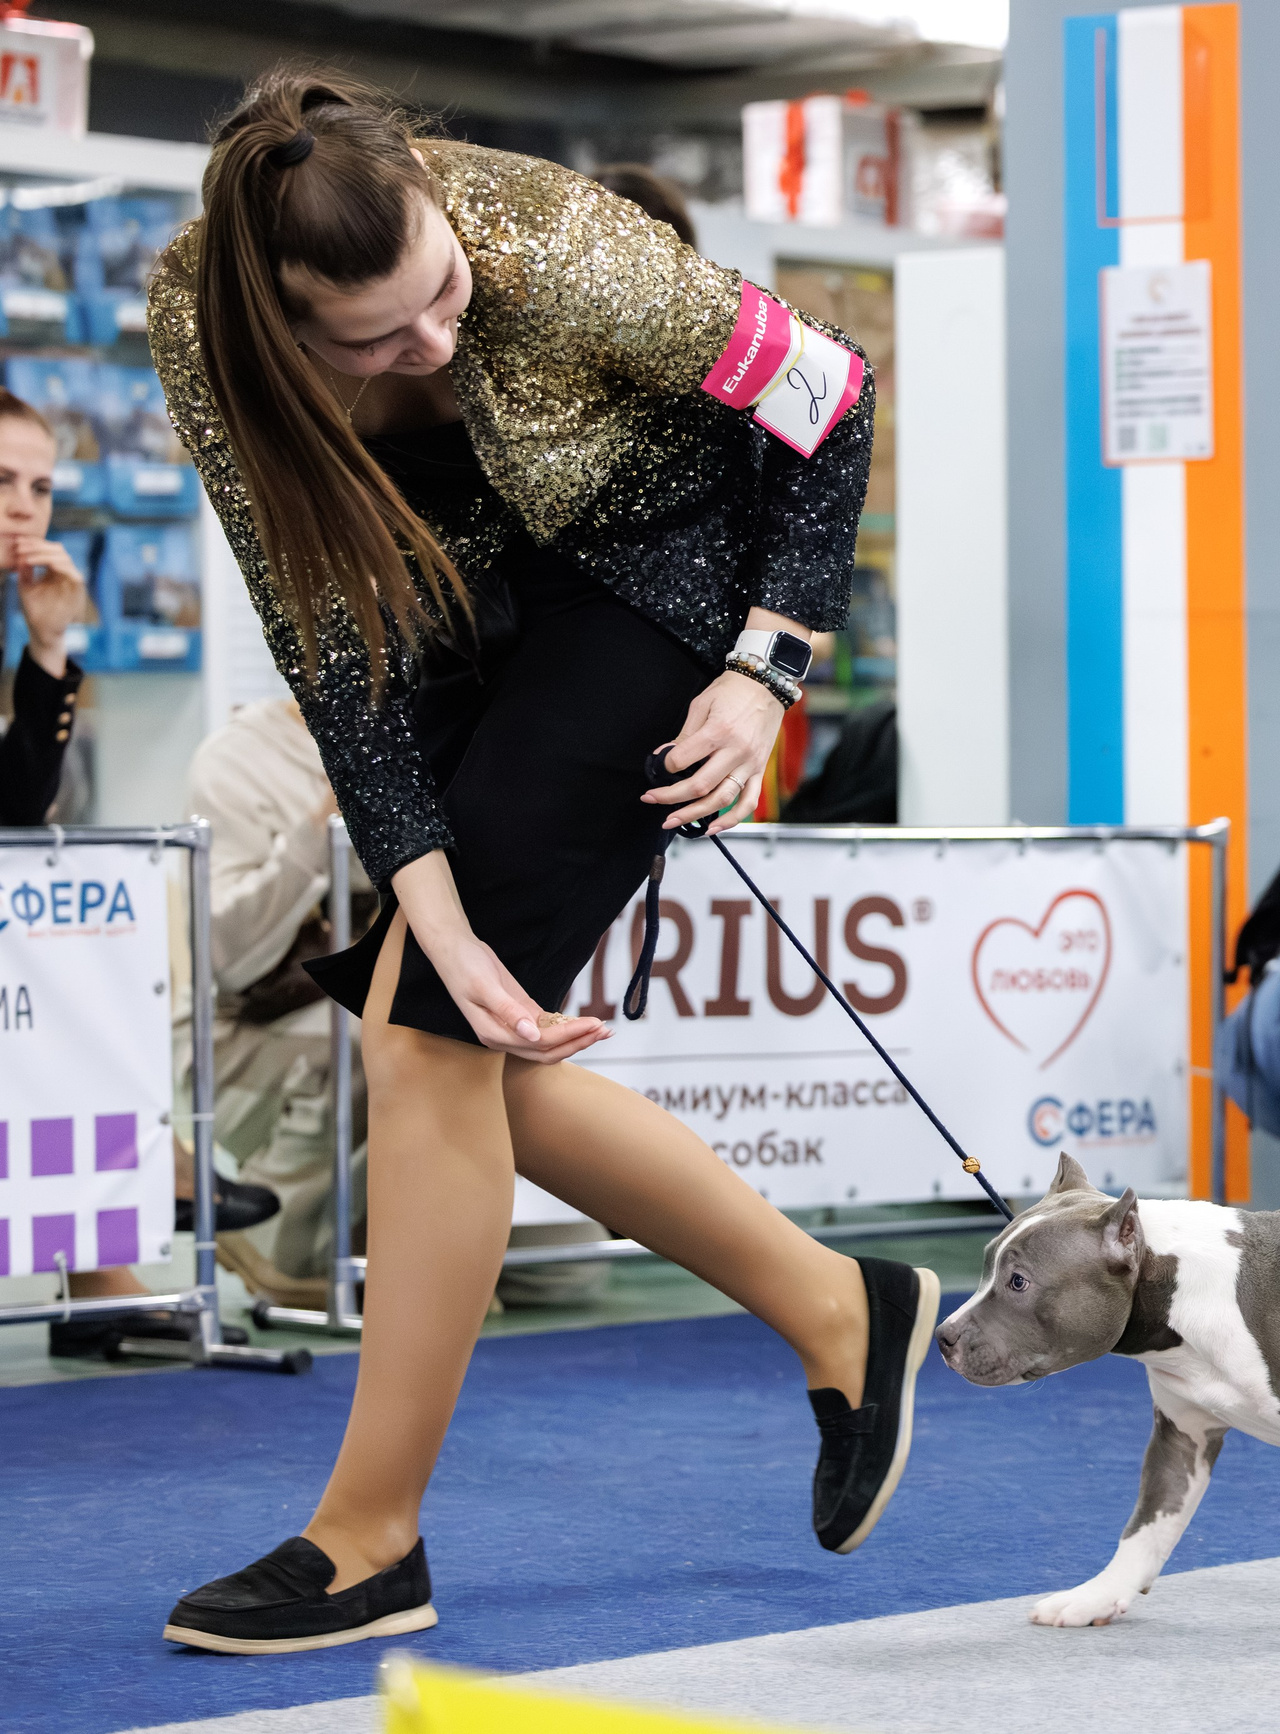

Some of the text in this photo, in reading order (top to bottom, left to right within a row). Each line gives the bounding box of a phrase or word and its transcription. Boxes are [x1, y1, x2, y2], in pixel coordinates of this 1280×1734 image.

[722, 299, 768, 394] Eukanuba
[786, 367, 827, 425] 2
[990, 969, 1092, 992] ЛЮБОВЬ
[634, 1079, 908, 1121] емиум-класса
[1027, 1094, 1157, 1147] СФЕРА
